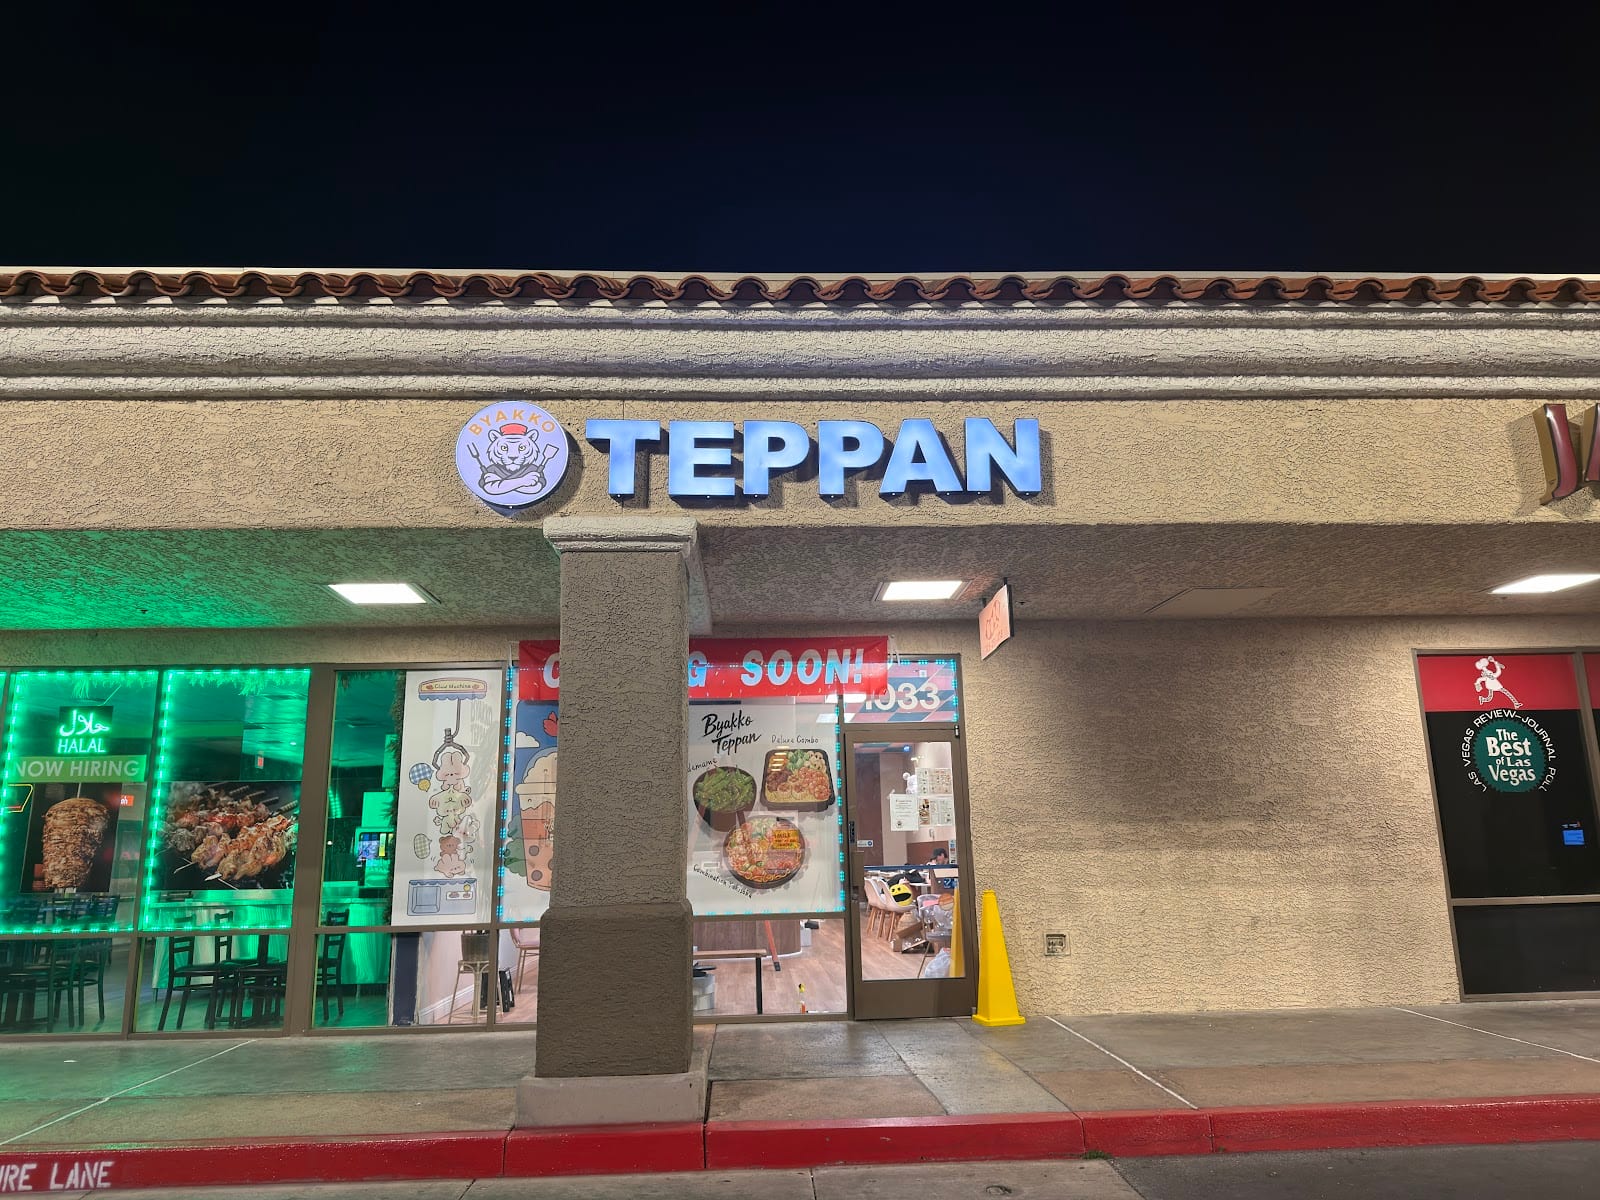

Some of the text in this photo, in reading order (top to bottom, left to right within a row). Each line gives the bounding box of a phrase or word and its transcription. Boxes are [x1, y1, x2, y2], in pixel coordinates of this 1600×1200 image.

[469, 409, 555, 436] BYAKKO
[585, 417, 1041, 497] TEPPAN
[740, 648, 865, 687] SOON!
[702, 710, 753, 737] Byakko
[1495, 728, 1518, 740] The
[57, 738, 107, 753] HALAL
[712, 732, 761, 755] Teppan
[796, 734, 819, 744] Combo
[1462, 728, 1475, 767] VEGAS
[1486, 736, 1532, 757] Best
[69, 760, 140, 777] HIRING
[687, 757, 718, 773] demame
[1495, 756, 1531, 767] of Las
[1468, 771, 1487, 792] LAS
[1488, 765, 1536, 786] Vegas
[1538, 767, 1557, 792] POLL
[0, 1161, 115, 1192] IRE LANE
